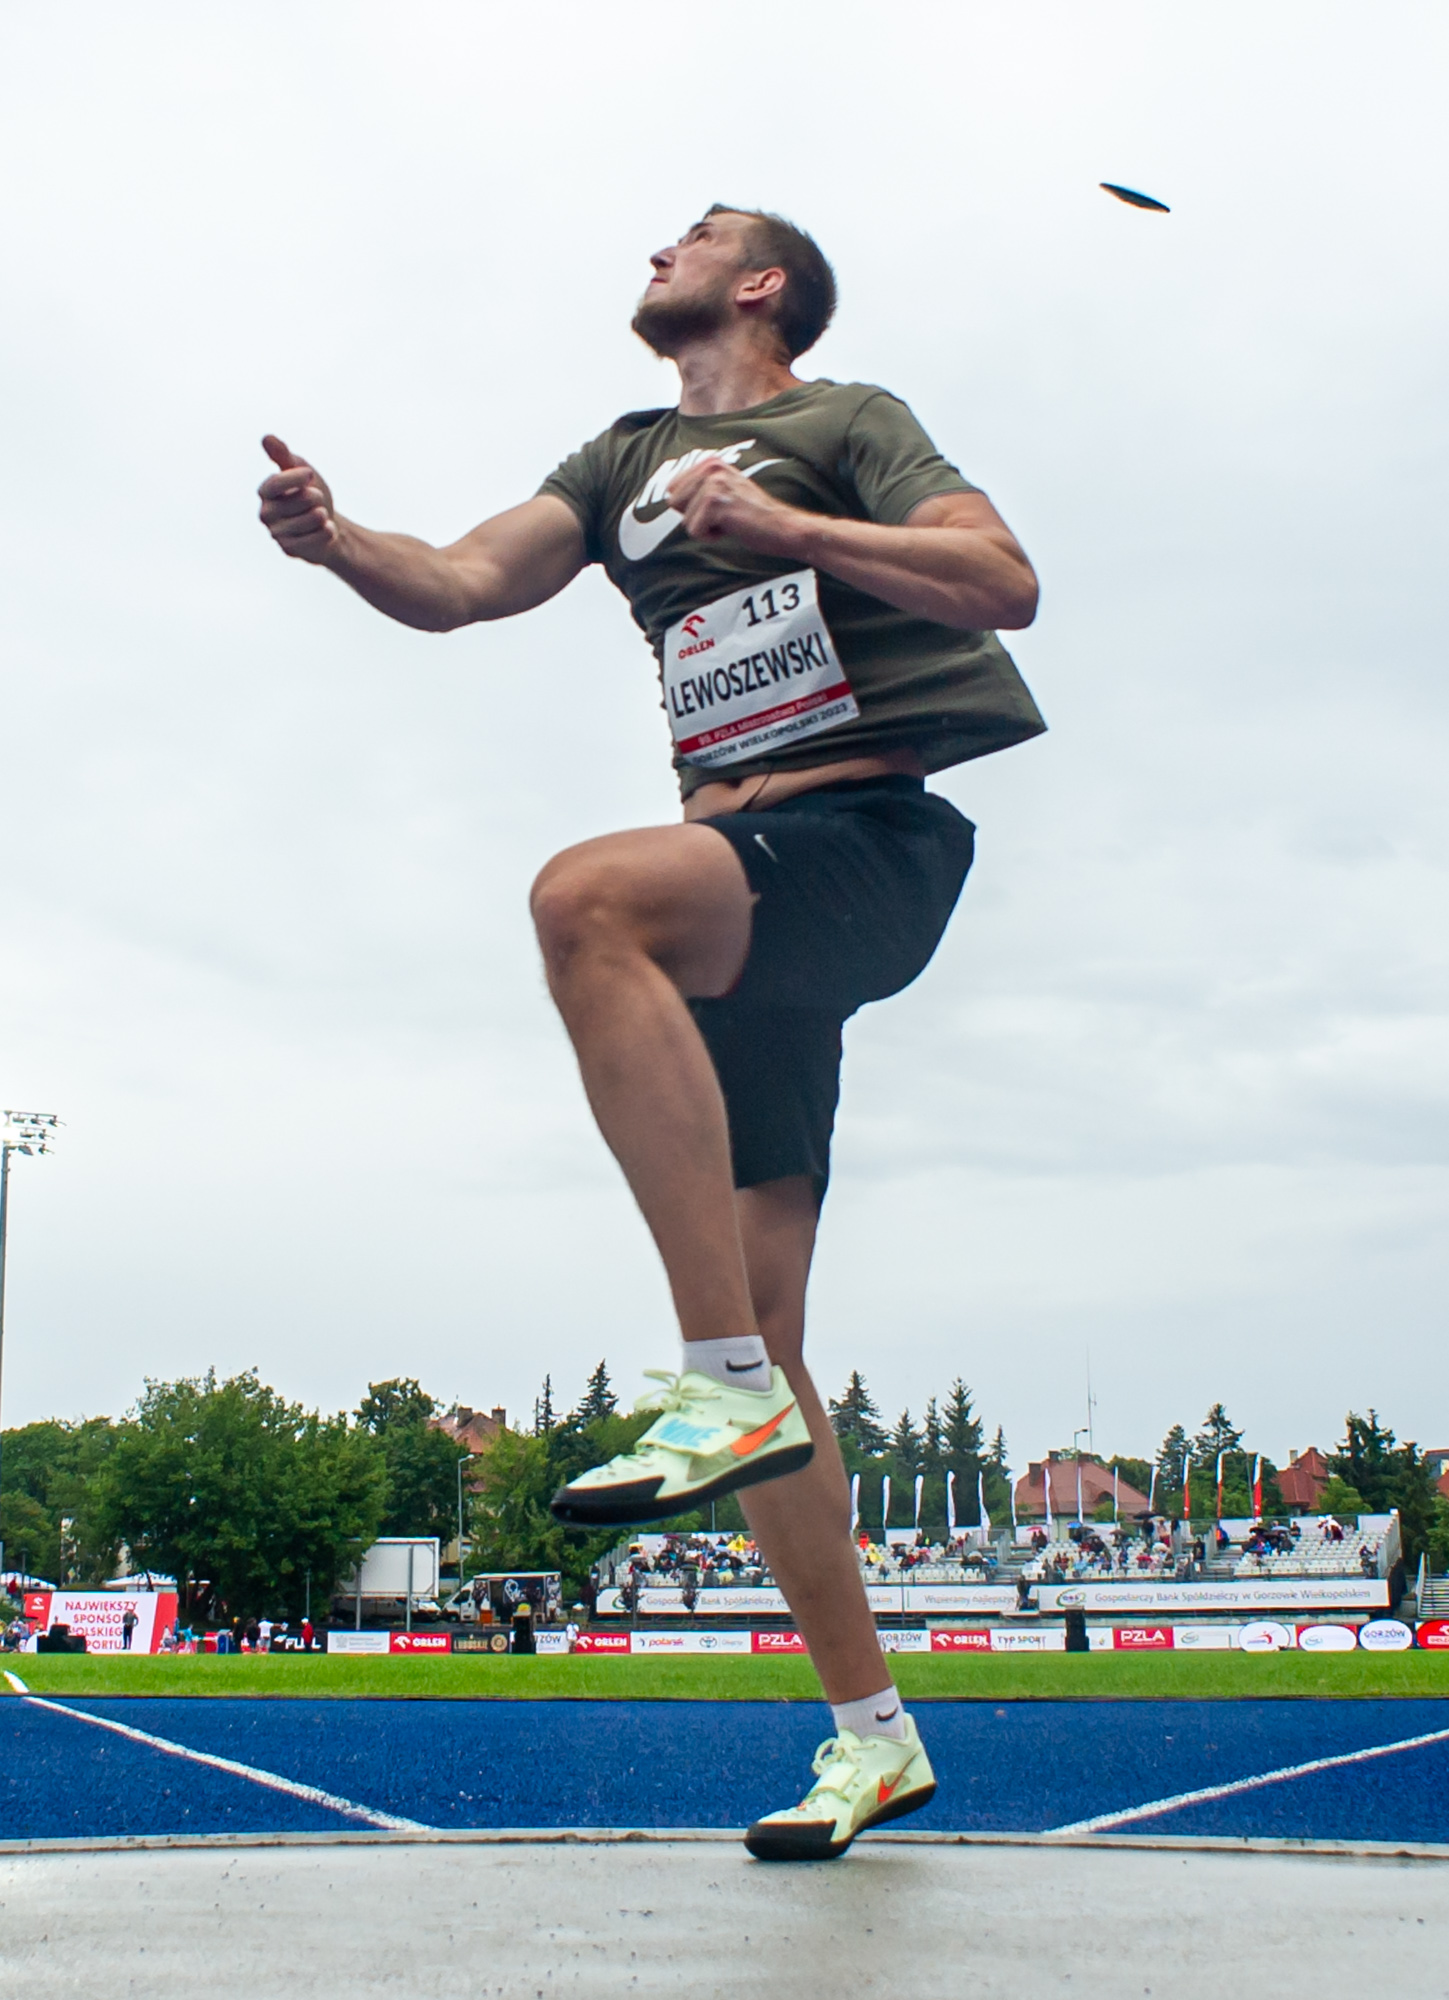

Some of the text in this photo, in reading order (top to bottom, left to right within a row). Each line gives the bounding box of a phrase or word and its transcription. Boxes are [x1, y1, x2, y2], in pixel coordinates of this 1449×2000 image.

[741, 583, 799, 627] 113
[678, 638, 715, 659] ORLEN
[670, 632, 828, 719] LEWOSZEWSKI
[739, 715, 819, 750] WIELKOPOLSKI
[819, 702, 848, 721] 2023
[1095, 1593, 1153, 1603] Gospodarczy
[1157, 1592, 1178, 1601] Bank
[1254, 1591, 1297, 1600] Gorzowie
[1301, 1589, 1371, 1599] Wielkopolskim
[65, 1601, 138, 1612] NAJWIĘKSZY
[74, 1614, 122, 1623] SPONSO
[879, 1631, 922, 1642] GORZÓW
[1120, 1630, 1165, 1641] PZLA
[1364, 1628, 1405, 1638] GORZÓW
[86, 1640, 122, 1649] PORTU
[413, 1637, 446, 1647] ORLEN
[594, 1637, 627, 1647] ORLEN
[758, 1633, 802, 1646] PZLA
[953, 1635, 988, 1645] ORLEN
